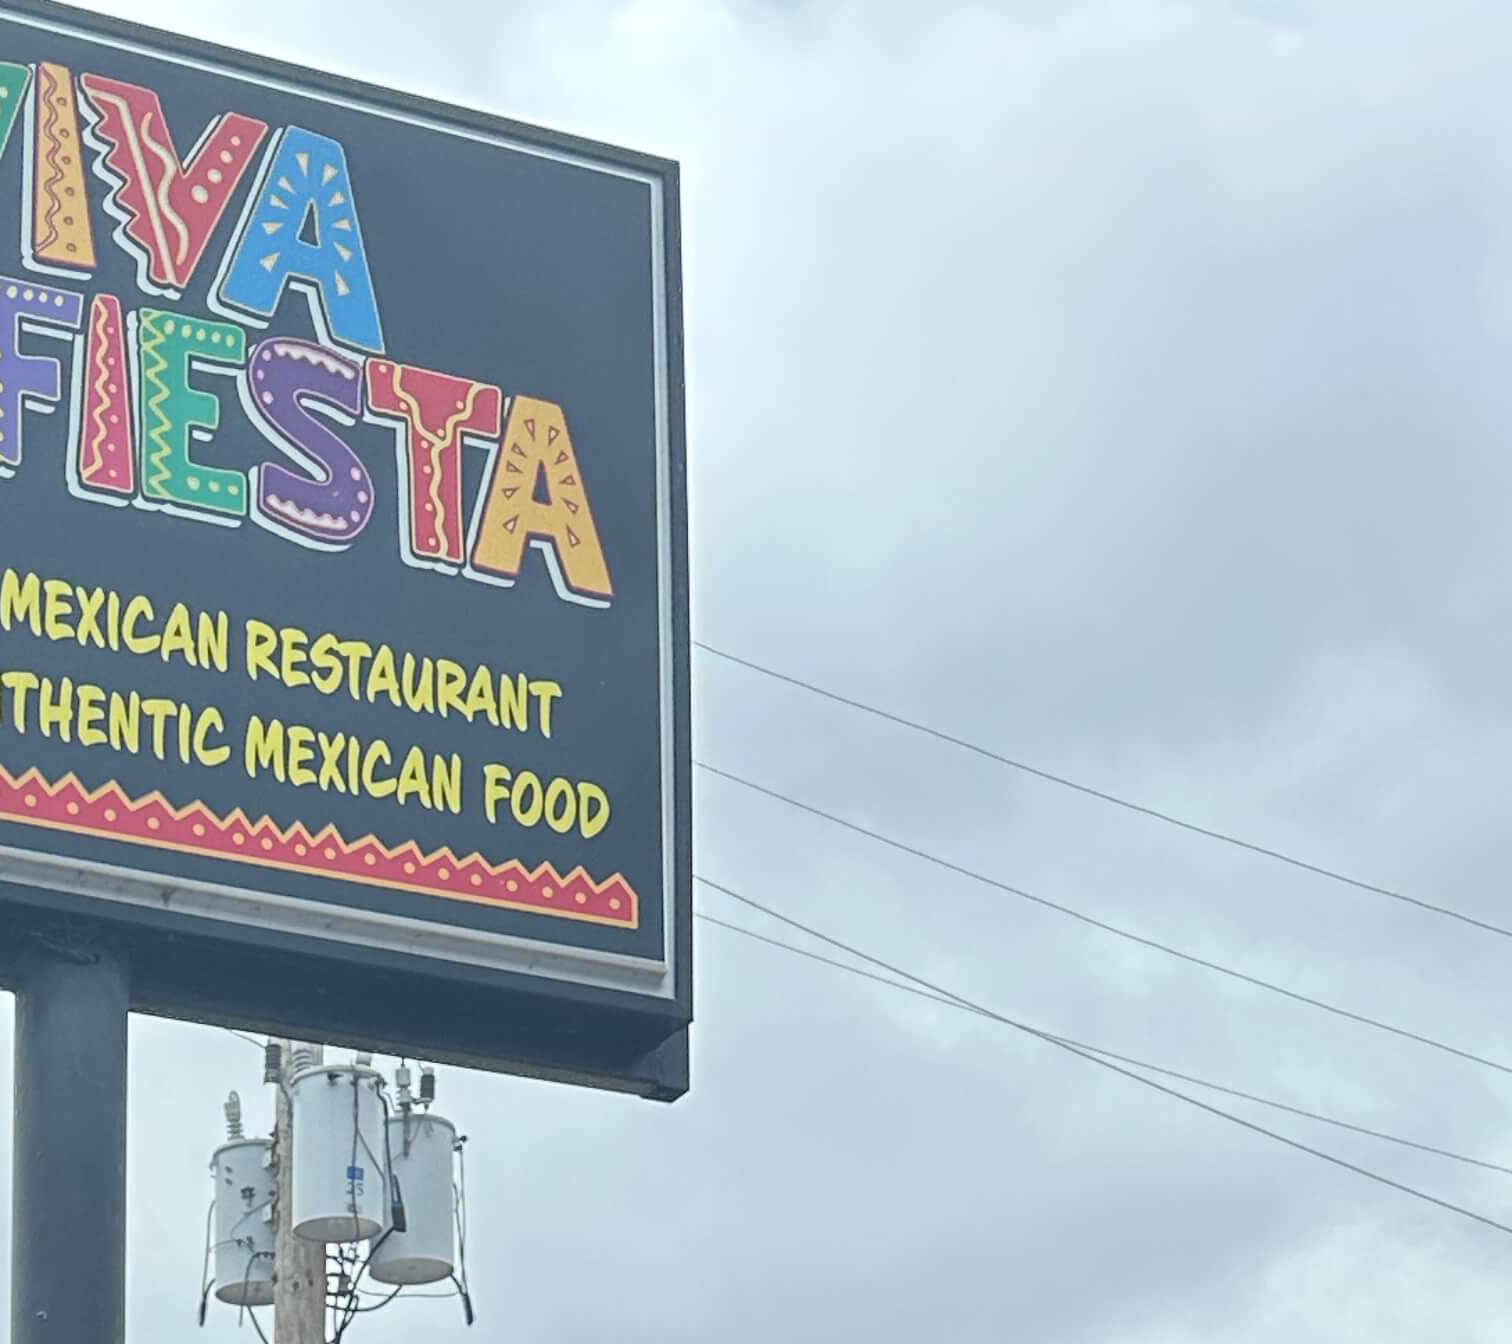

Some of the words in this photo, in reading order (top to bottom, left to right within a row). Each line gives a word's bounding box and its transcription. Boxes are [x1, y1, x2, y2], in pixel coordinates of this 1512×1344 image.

[0, 568, 231, 672] MEXICAN
[244, 620, 563, 737] RESTAURANT
[245, 721, 463, 813] MEXICAN
[482, 763, 609, 838] FOOD
